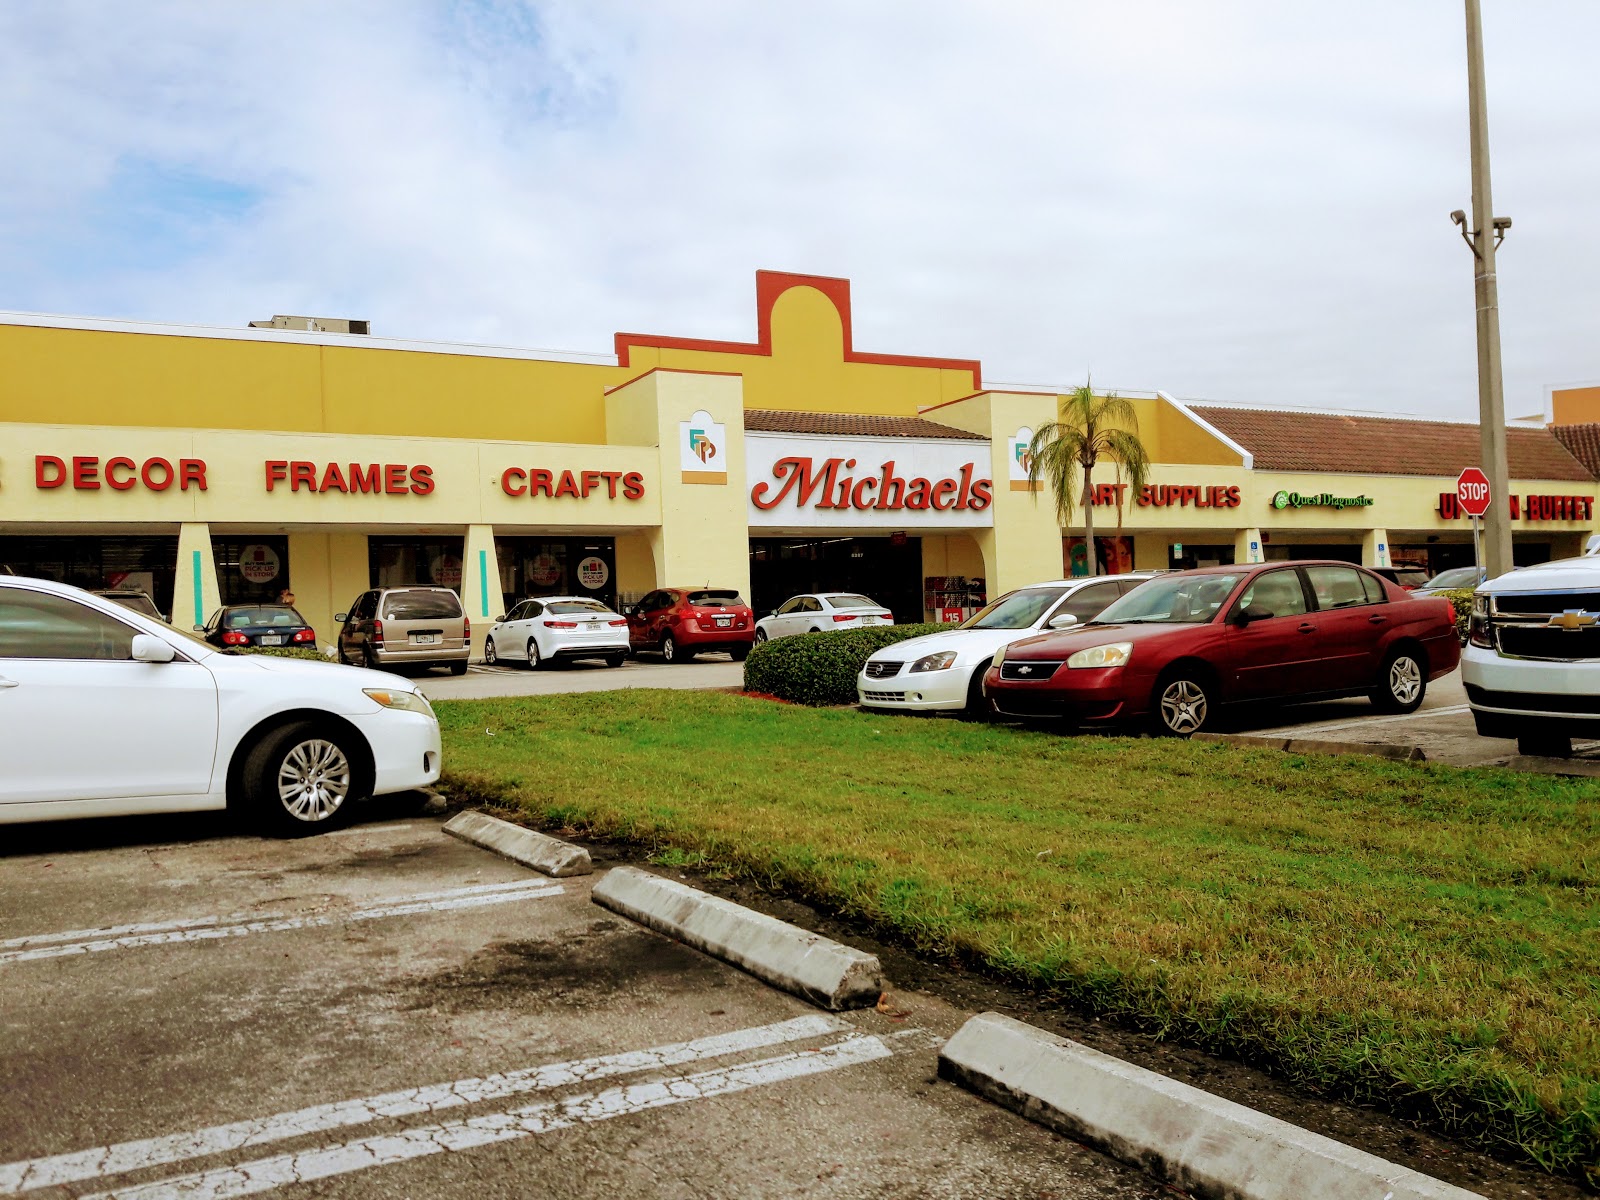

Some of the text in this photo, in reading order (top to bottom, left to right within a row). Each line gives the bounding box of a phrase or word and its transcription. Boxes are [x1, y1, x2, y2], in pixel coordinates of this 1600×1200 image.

[35, 455, 208, 491] DECOR
[265, 460, 436, 495] FRAMES
[501, 467, 645, 500] CRAFTS
[751, 457, 993, 511] Michaels
[1080, 483, 1242, 508] ART SUPPLIES
[1289, 492, 1374, 509] Quest Diagnostics
[1460, 483, 1488, 500] STOP
[1527, 495, 1595, 520] BUFFET
[945, 612, 960, 622] $15
